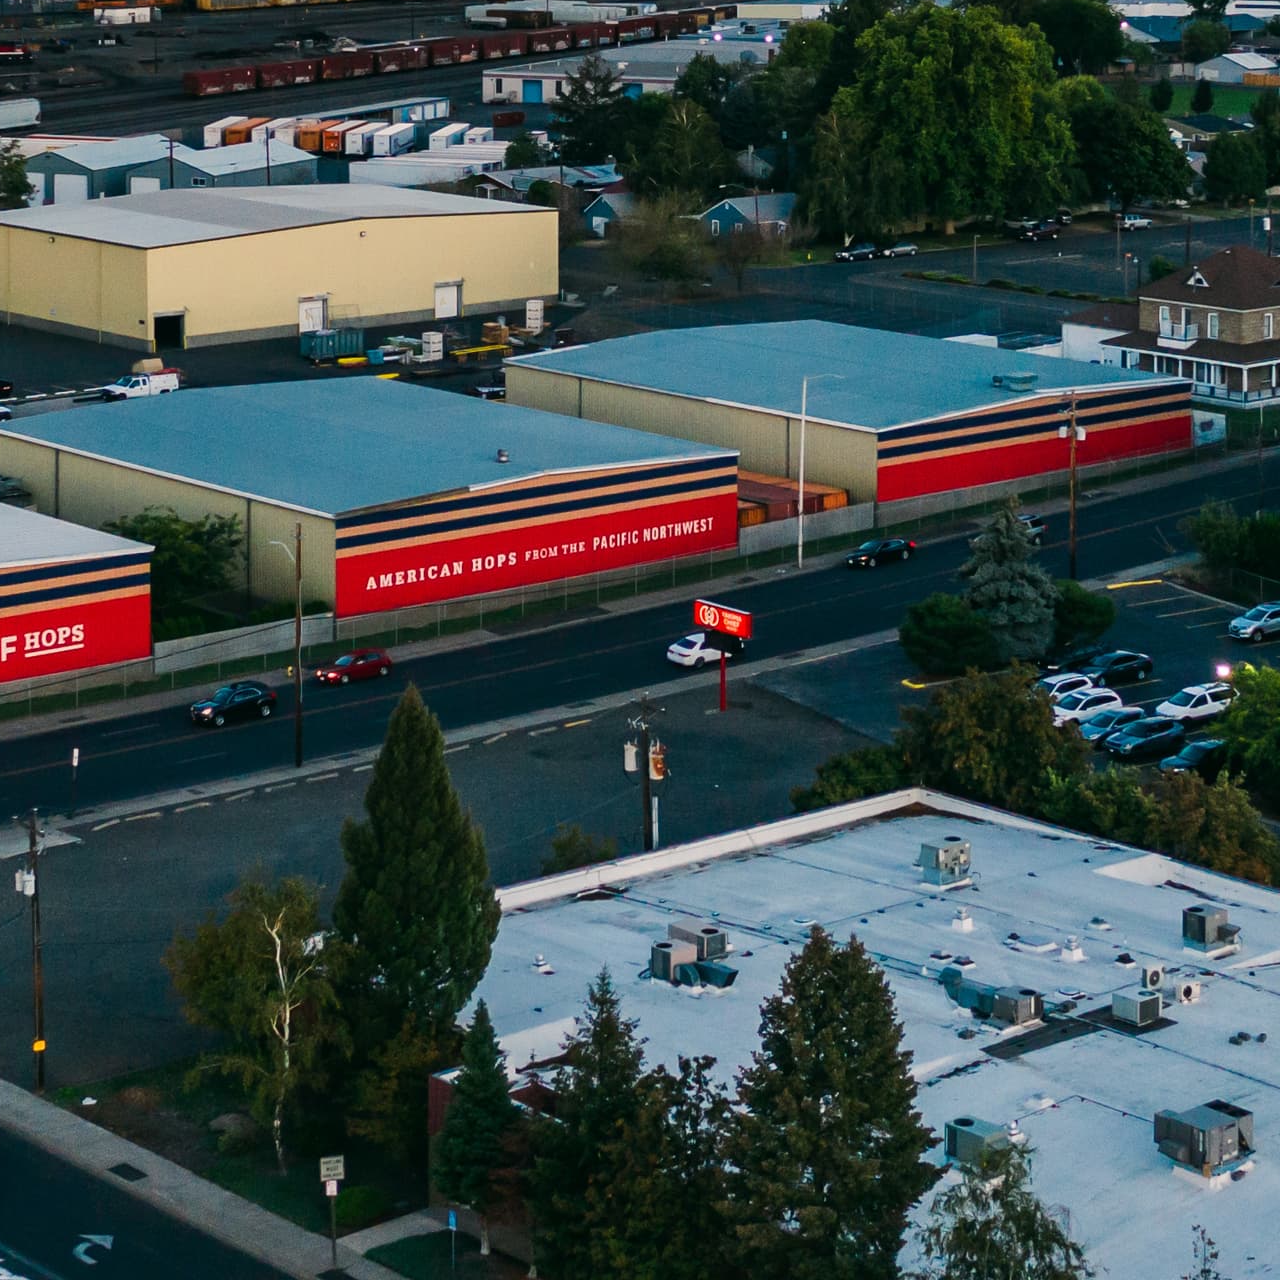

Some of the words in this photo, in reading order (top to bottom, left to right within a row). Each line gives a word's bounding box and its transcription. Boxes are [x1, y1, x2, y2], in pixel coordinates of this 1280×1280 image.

[366, 561, 464, 590] AMERICAN
[472, 552, 518, 572] HOPS
[525, 546, 558, 562] FROM
[562, 541, 586, 555] THE
[592, 529, 639, 551] PACIFIC
[643, 517, 714, 542] NORTHWEST
[23, 623, 85, 652] HOPS
